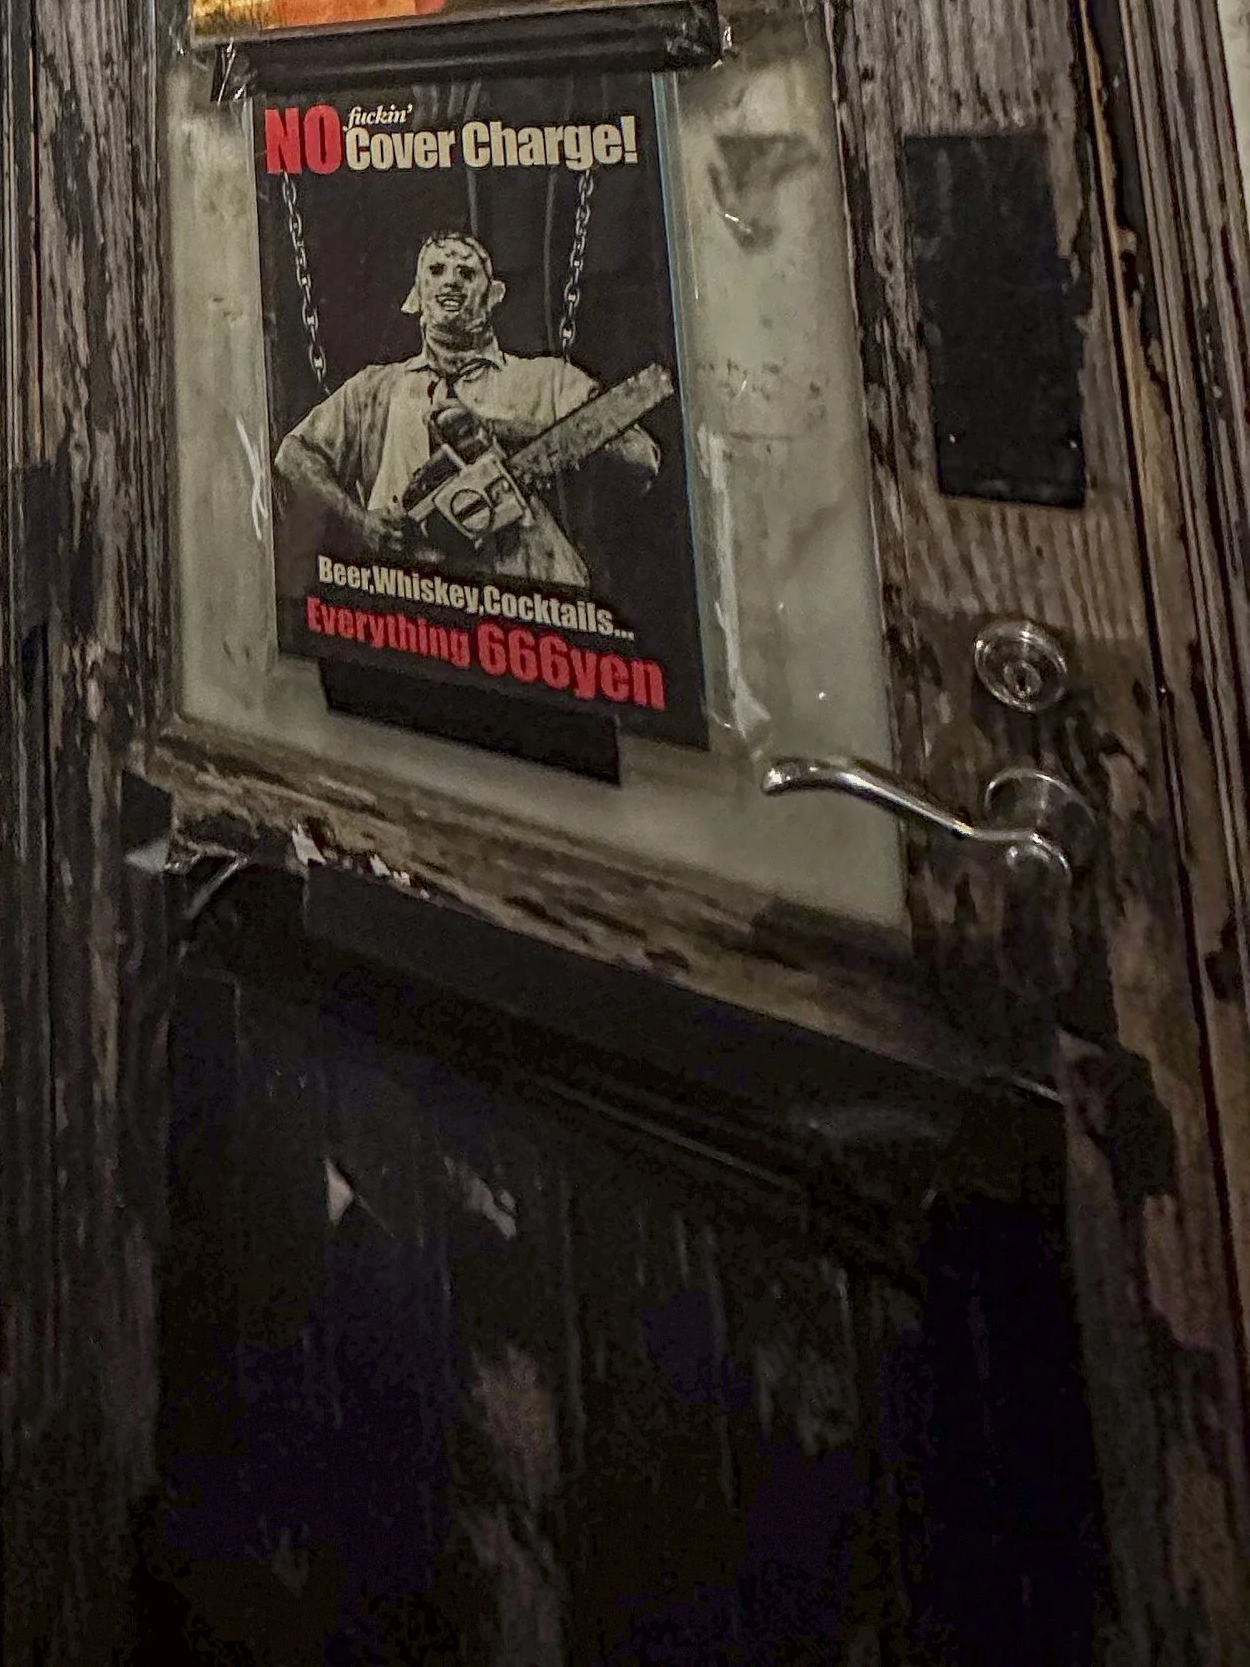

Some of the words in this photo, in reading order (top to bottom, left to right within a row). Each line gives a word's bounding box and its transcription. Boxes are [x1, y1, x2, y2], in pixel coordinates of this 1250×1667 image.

[264, 104, 343, 175] NO
[345, 126, 456, 171] Cover
[461, 115, 639, 171] Charge!
[345, 104, 414, 131] fuckin'
[306, 596, 471, 671] Everything
[476, 618, 666, 711] 666yen
